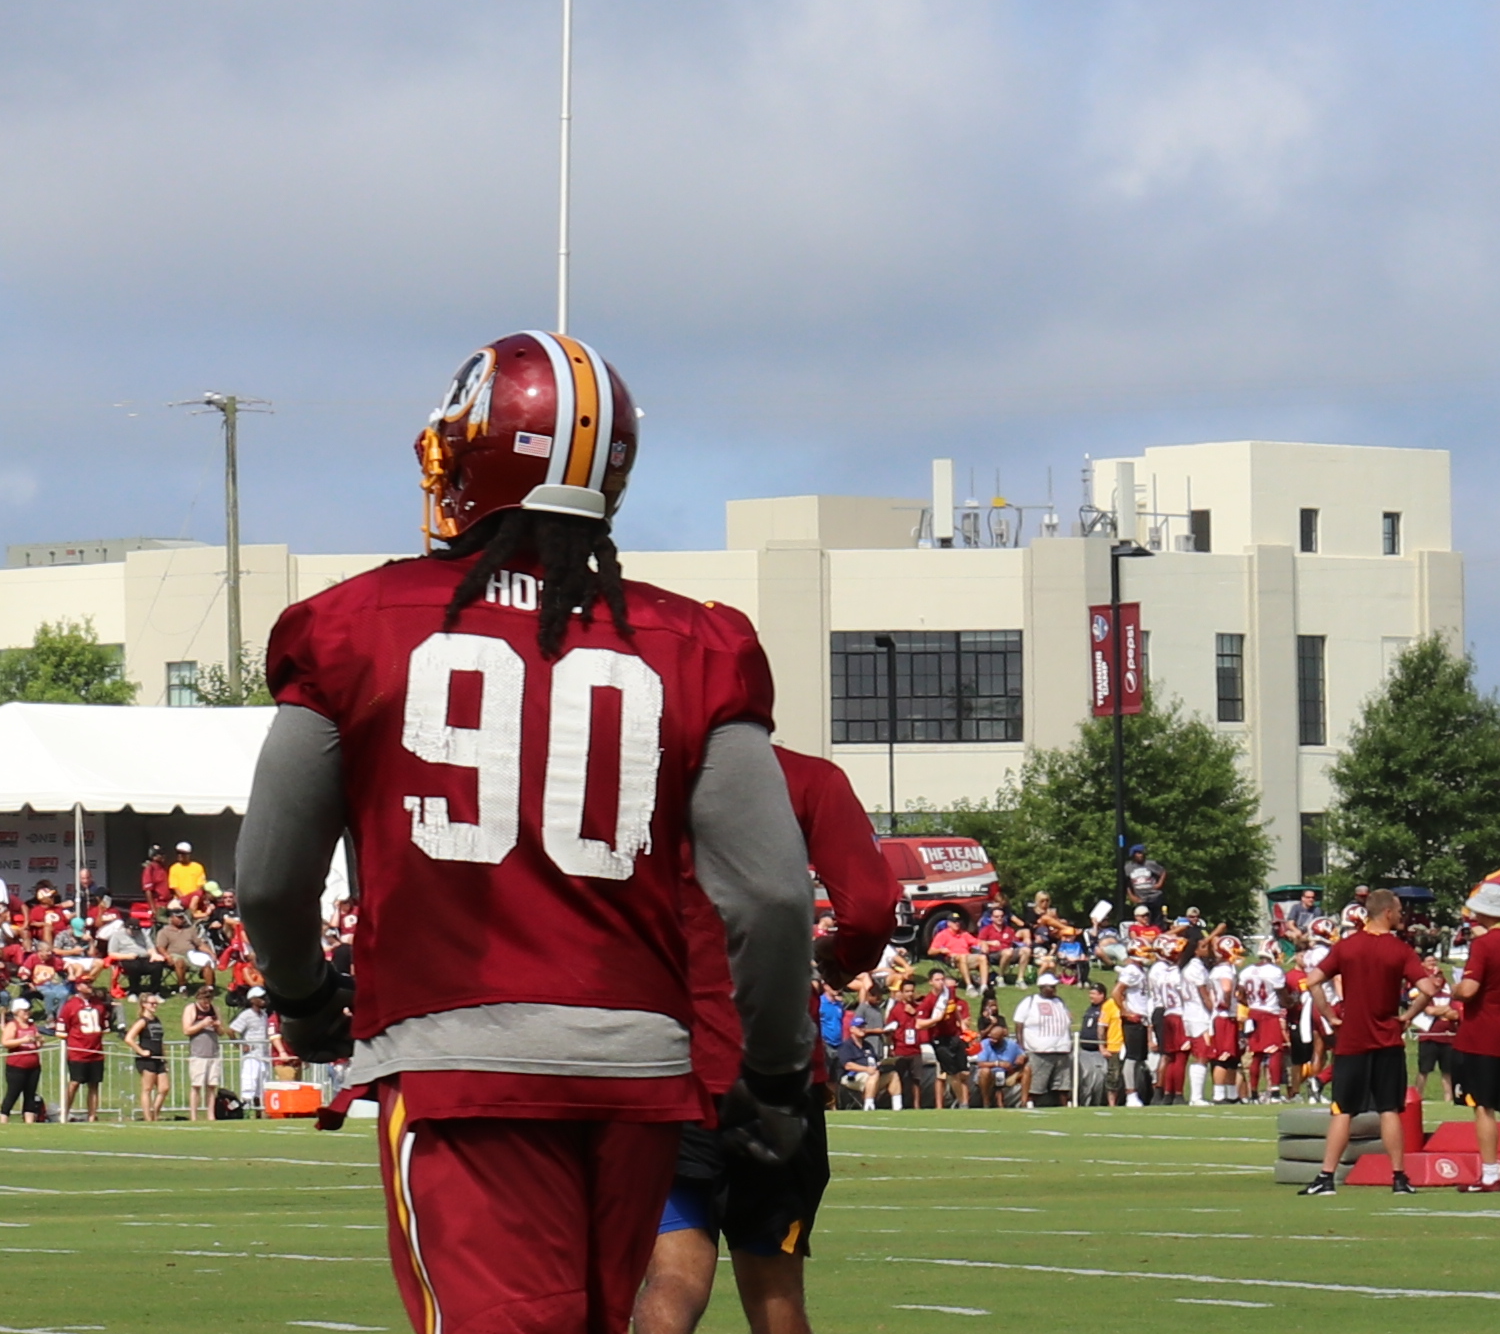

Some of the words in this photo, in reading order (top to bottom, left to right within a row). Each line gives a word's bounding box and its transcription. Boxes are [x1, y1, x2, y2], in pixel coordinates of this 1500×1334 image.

[401, 631, 664, 881] 90
[918, 847, 946, 864] THE
[946, 846, 989, 864] TEAM
[942, 860, 972, 872] 980
[1245, 979, 1267, 1005] 84
[78, 1007, 101, 1034] 91
[270, 1092, 280, 1110] G
